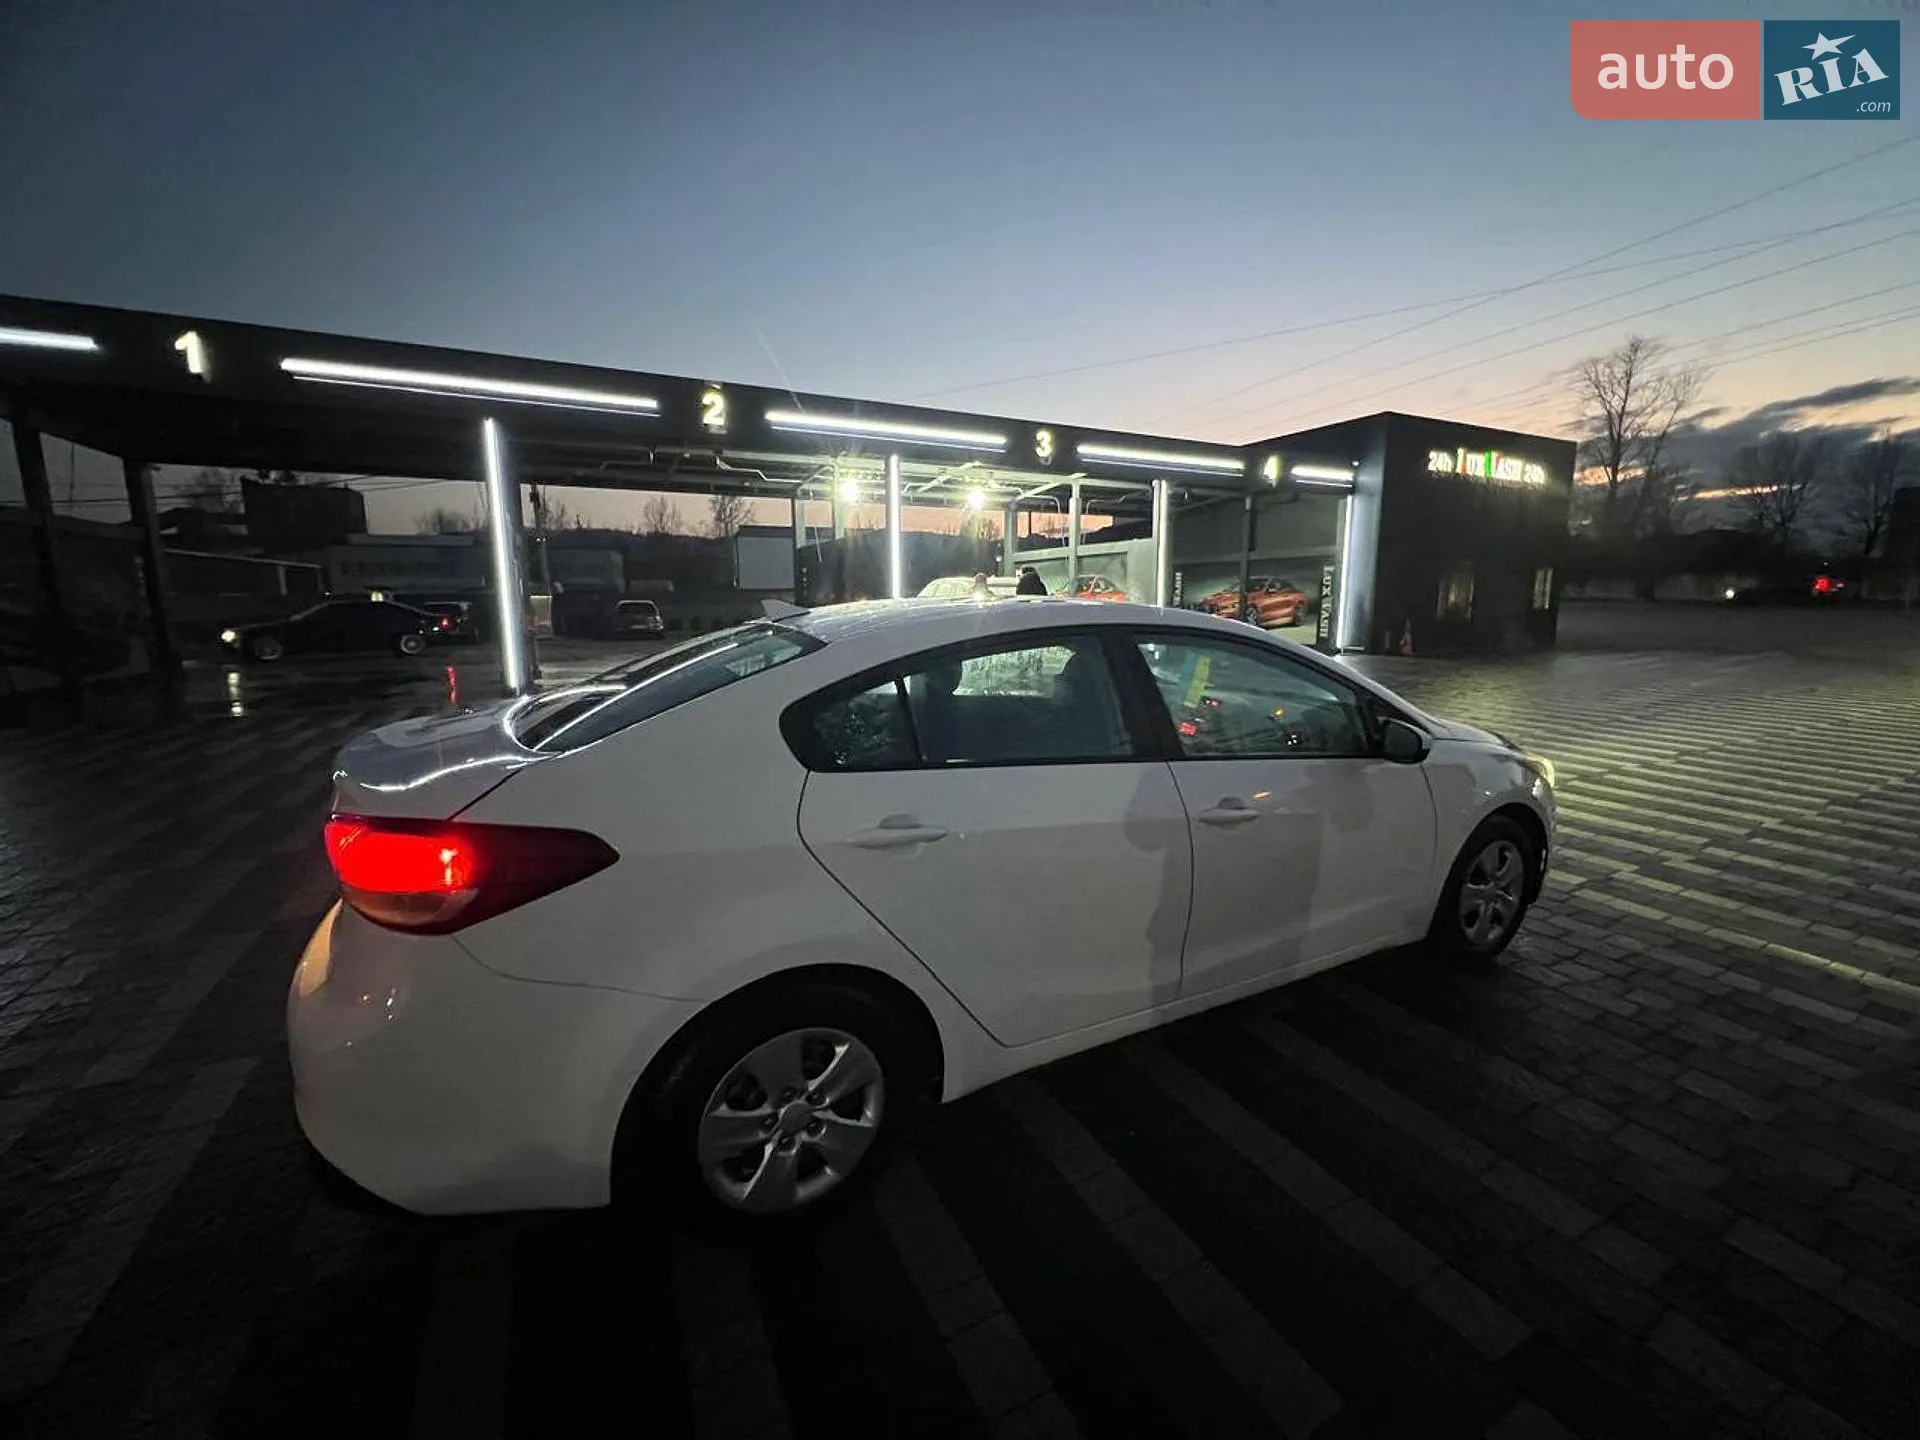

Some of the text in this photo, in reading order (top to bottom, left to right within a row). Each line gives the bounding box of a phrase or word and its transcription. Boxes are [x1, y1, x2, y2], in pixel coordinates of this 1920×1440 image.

[174, 331, 205, 374] 1
[702, 392, 725, 426] 2
[1036, 430, 1053, 458] 3
[1264, 456, 1279, 480] 4
